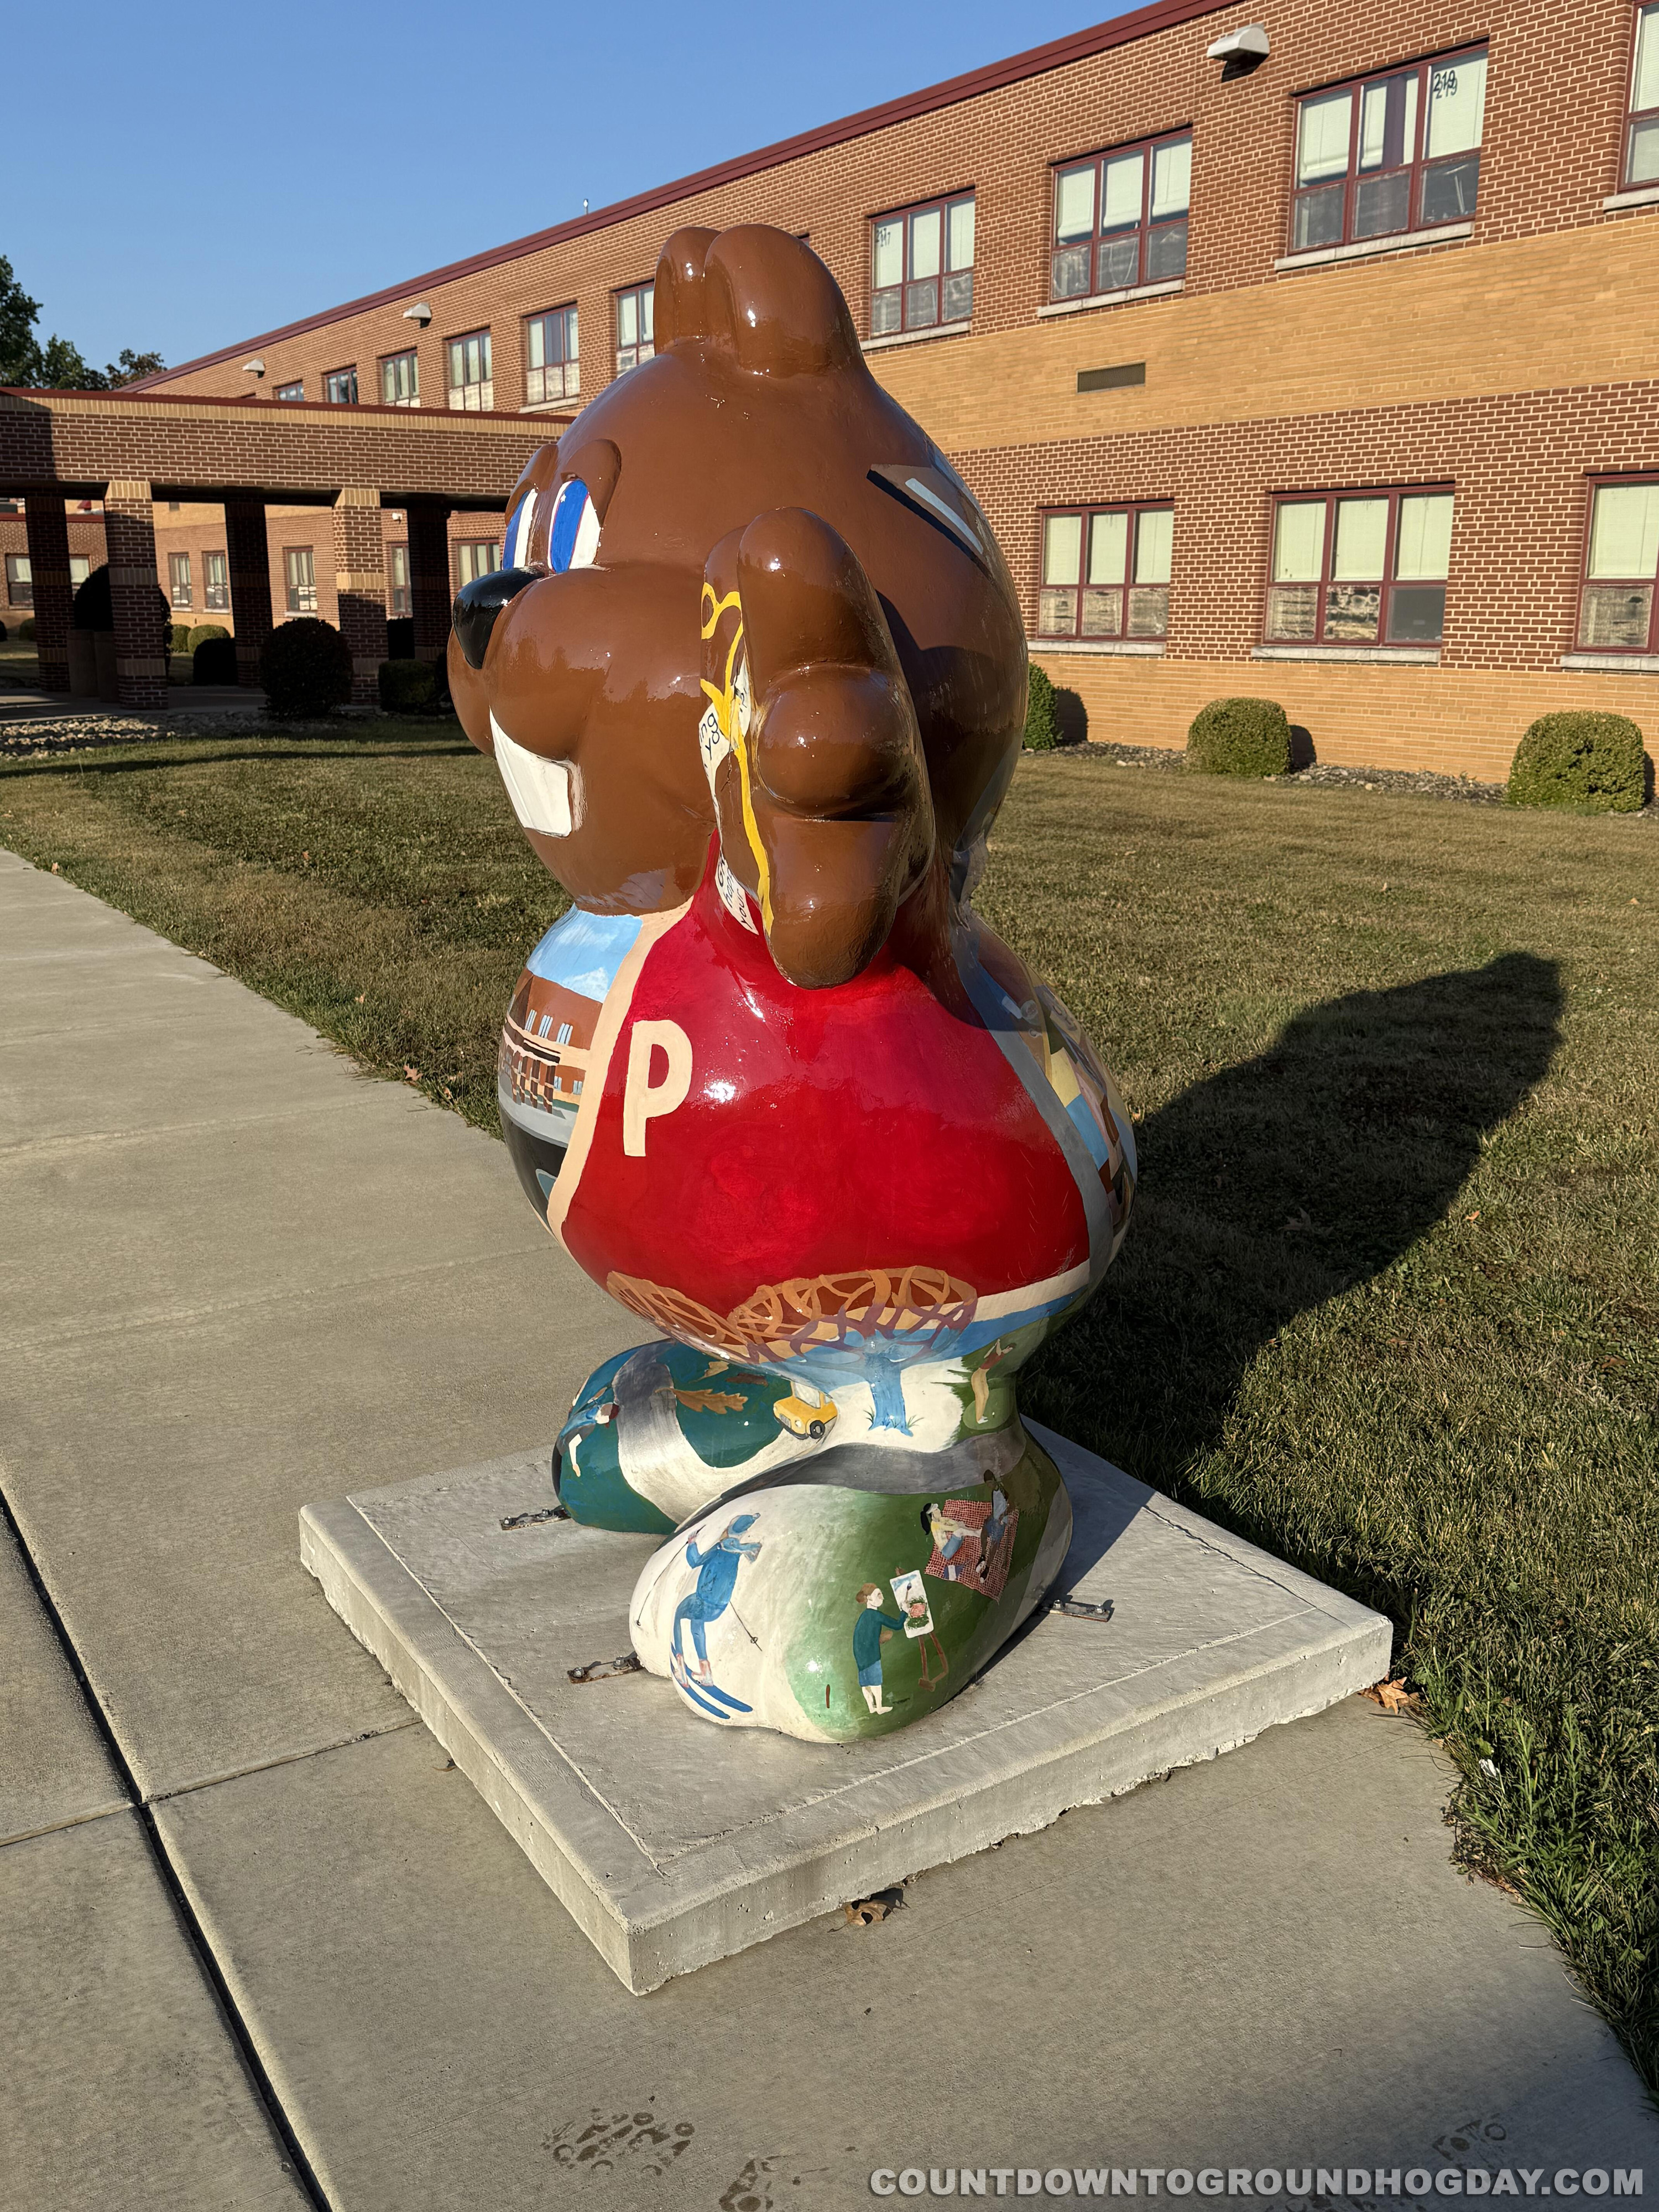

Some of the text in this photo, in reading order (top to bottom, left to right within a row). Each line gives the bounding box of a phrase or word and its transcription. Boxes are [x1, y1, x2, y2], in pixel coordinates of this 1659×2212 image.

[1433, 70, 1455, 92] 219
[737, 888, 753, 930] your
[623, 1020, 693, 1157] P
